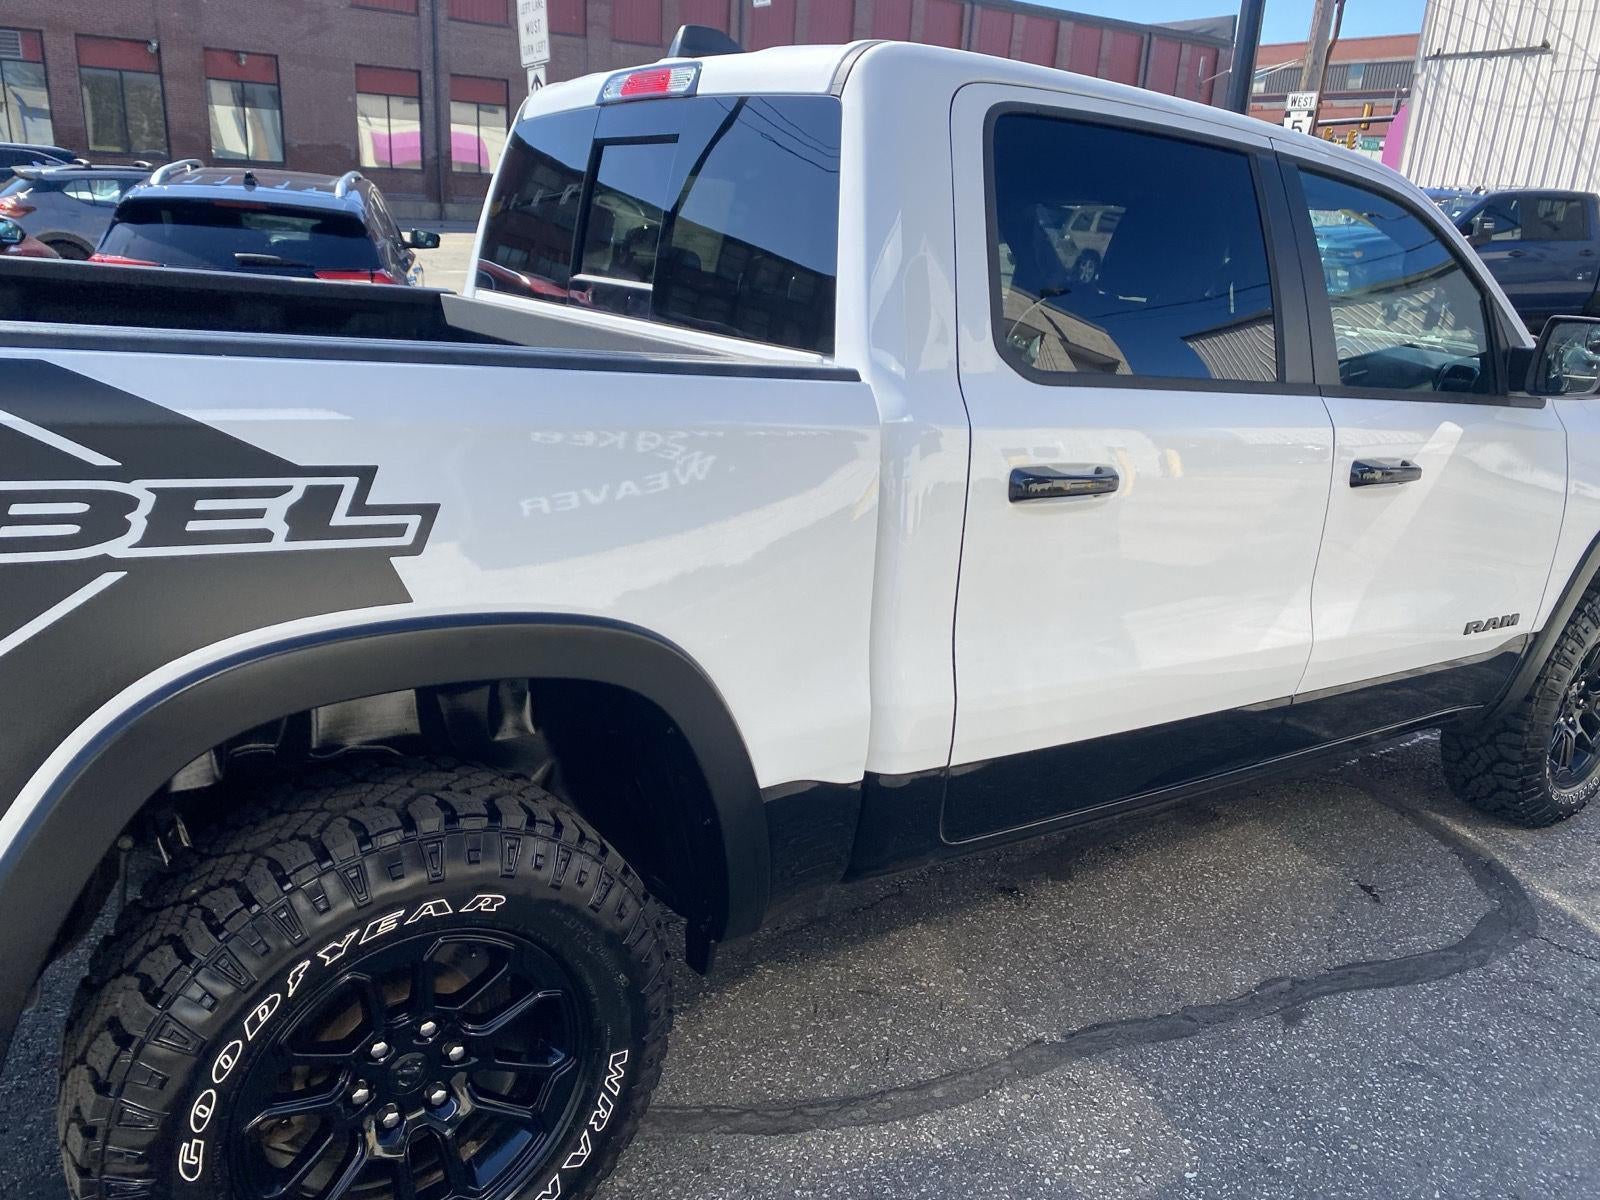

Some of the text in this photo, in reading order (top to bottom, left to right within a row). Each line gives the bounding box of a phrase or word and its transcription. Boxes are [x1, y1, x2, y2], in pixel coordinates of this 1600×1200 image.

[525, 18, 542, 34] MUST
[1290, 96, 1314, 107] WEST
[1463, 613, 1520, 635] RAM
[179, 894, 506, 1182] GOODYEAR
